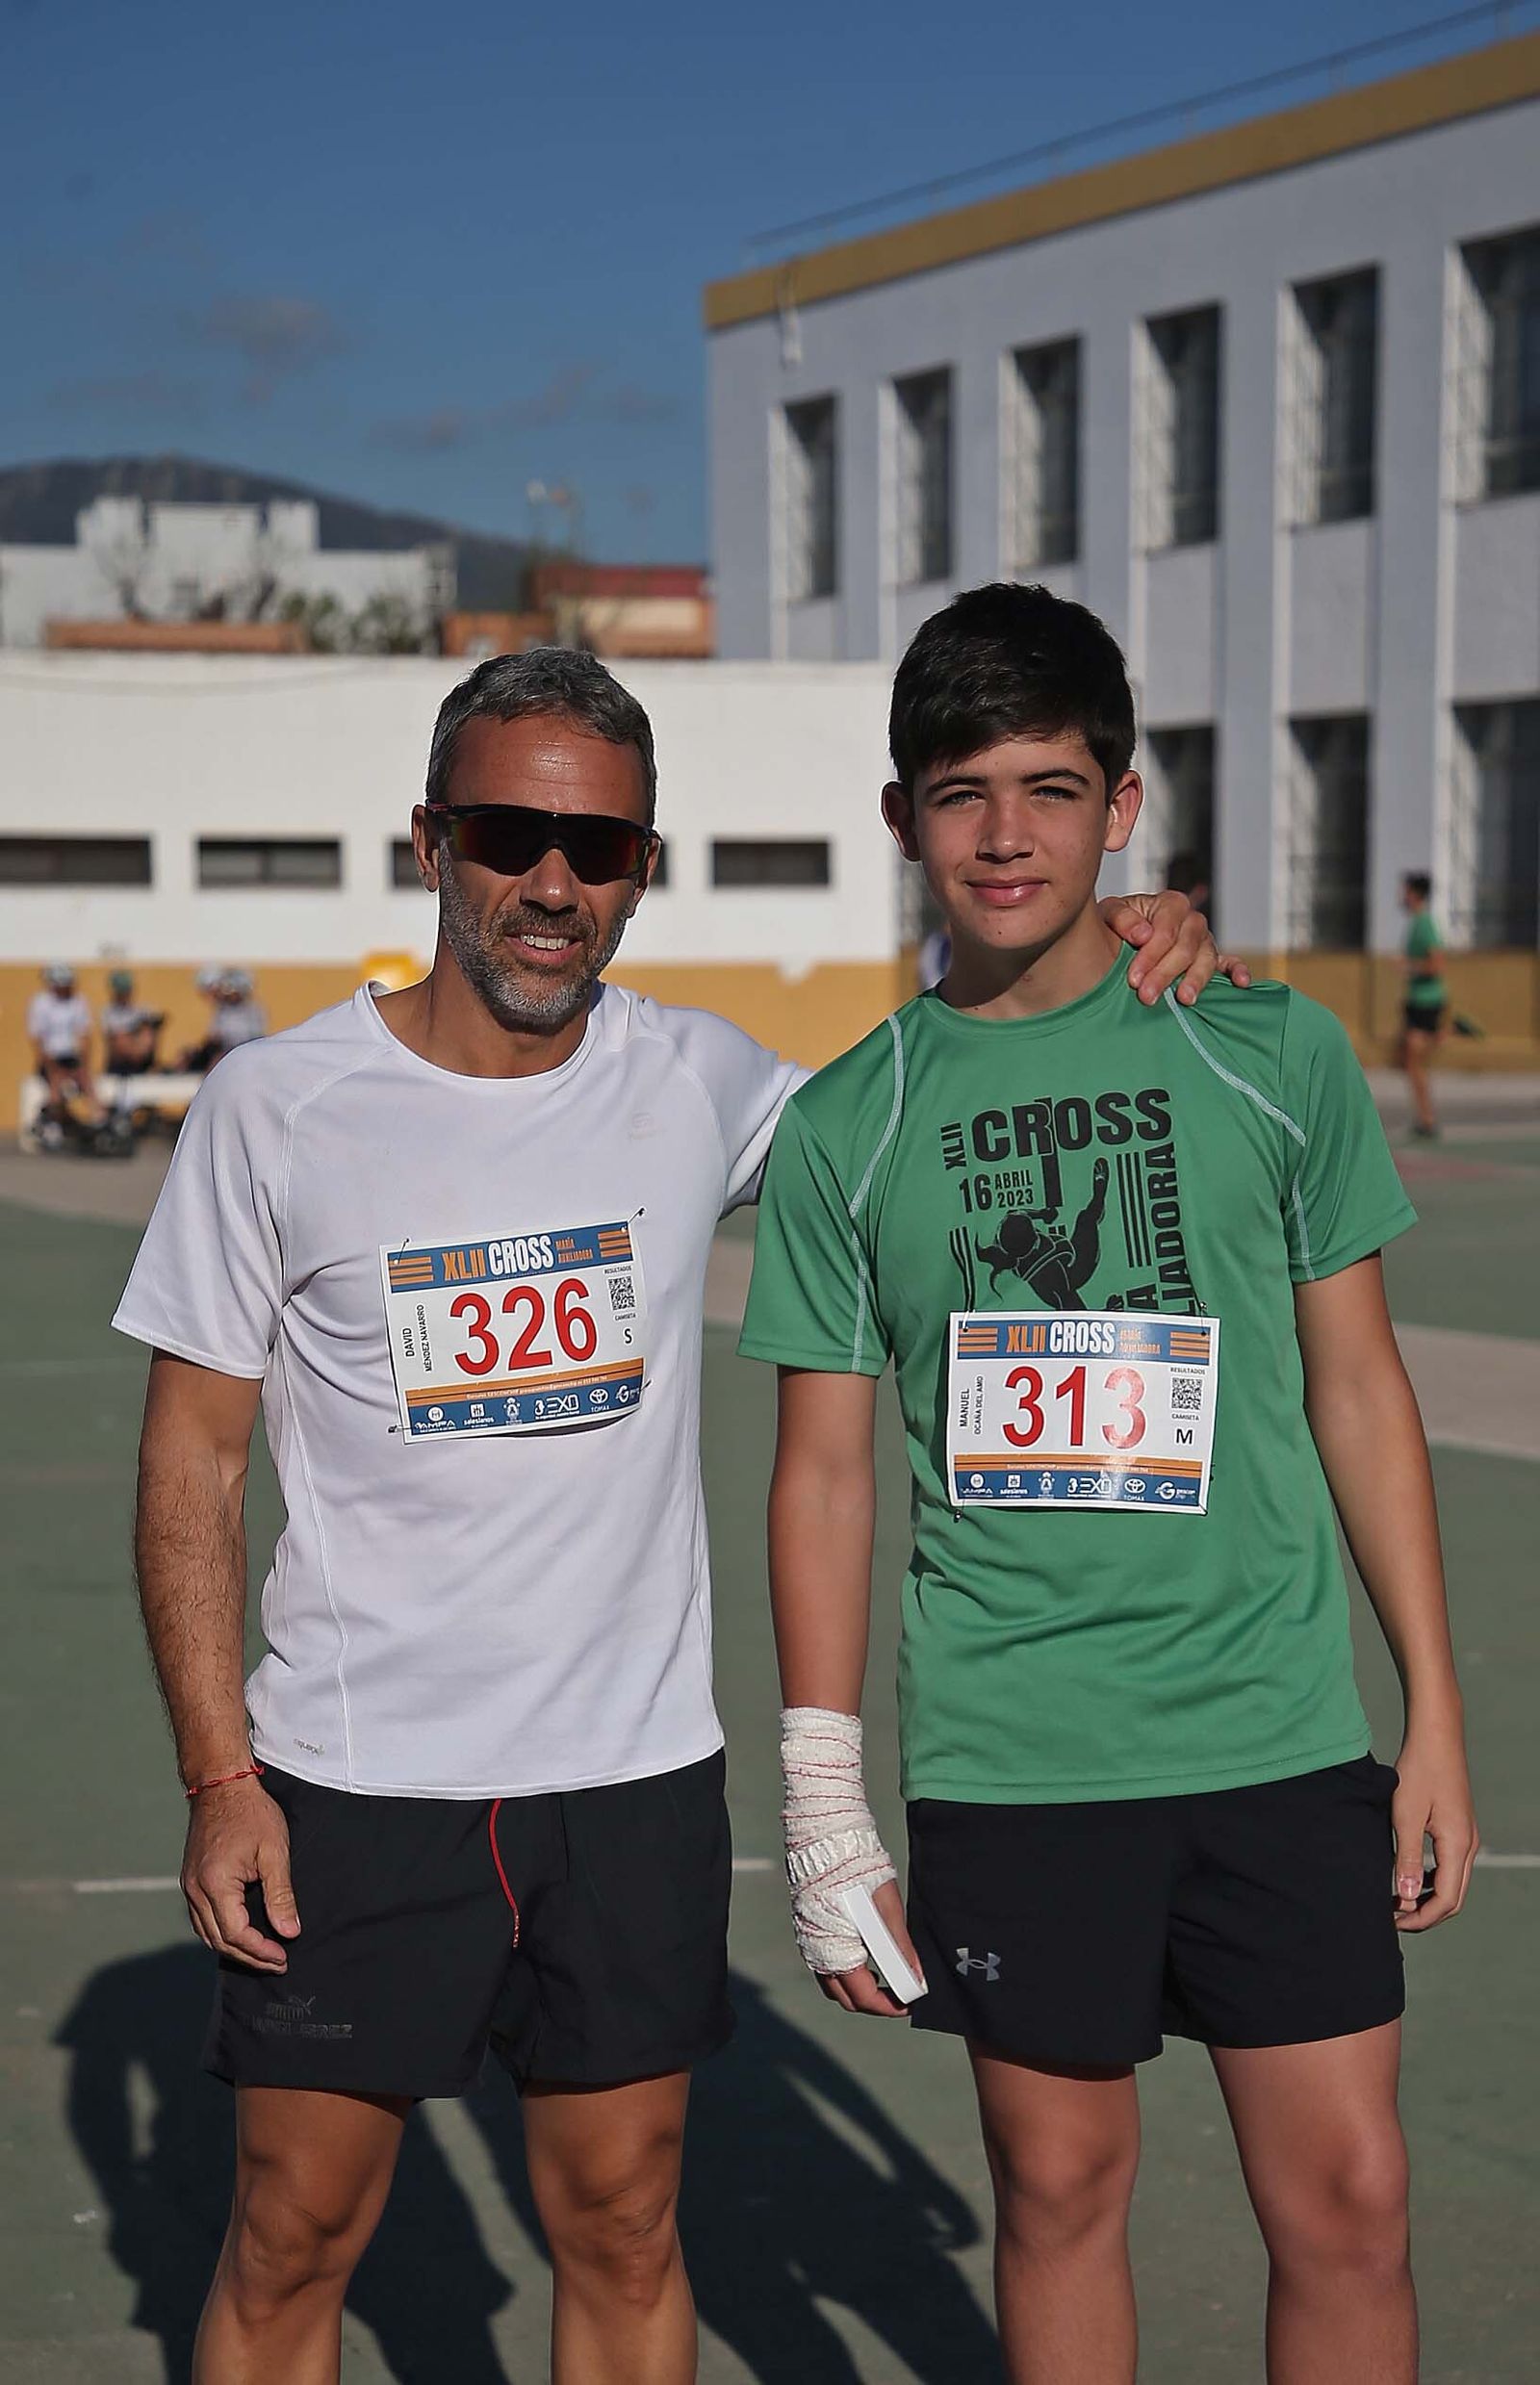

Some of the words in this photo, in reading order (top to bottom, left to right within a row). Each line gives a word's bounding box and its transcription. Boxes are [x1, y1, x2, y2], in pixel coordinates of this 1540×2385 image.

[971, 1089, 1172, 1162] CROSS
[940, 1122, 967, 1170] XLII
[959, 1173, 994, 1213] 16
[994, 1169, 1034, 1190] ABRIL
[997, 1189, 1035, 1208] 2023
[1144, 1141, 1196, 1316] LIADORA
[441, 1248, 487, 1282] XLII
[487, 1235, 555, 1276] CROSS
[603, 1265, 632, 1274] RESULTADOS
[416, 1304, 427, 1342] NAVARRO
[449, 1277, 599, 1376] 326
[615, 1312, 636, 1321] CAMISETA
[402, 1327, 415, 1357] DAVID
[624, 1328, 632, 1345] S
[1006, 1324, 1047, 1353] XLII
[1049, 1321, 1116, 1355] CROSS
[1169, 1367, 1206, 1375] RESULTADOS
[959, 1388, 970, 1427] MANUEL
[975, 1394, 984, 1408] DEL
[1001, 1365, 1147, 1450] 313
[1175, 1428, 1194, 1445] M
